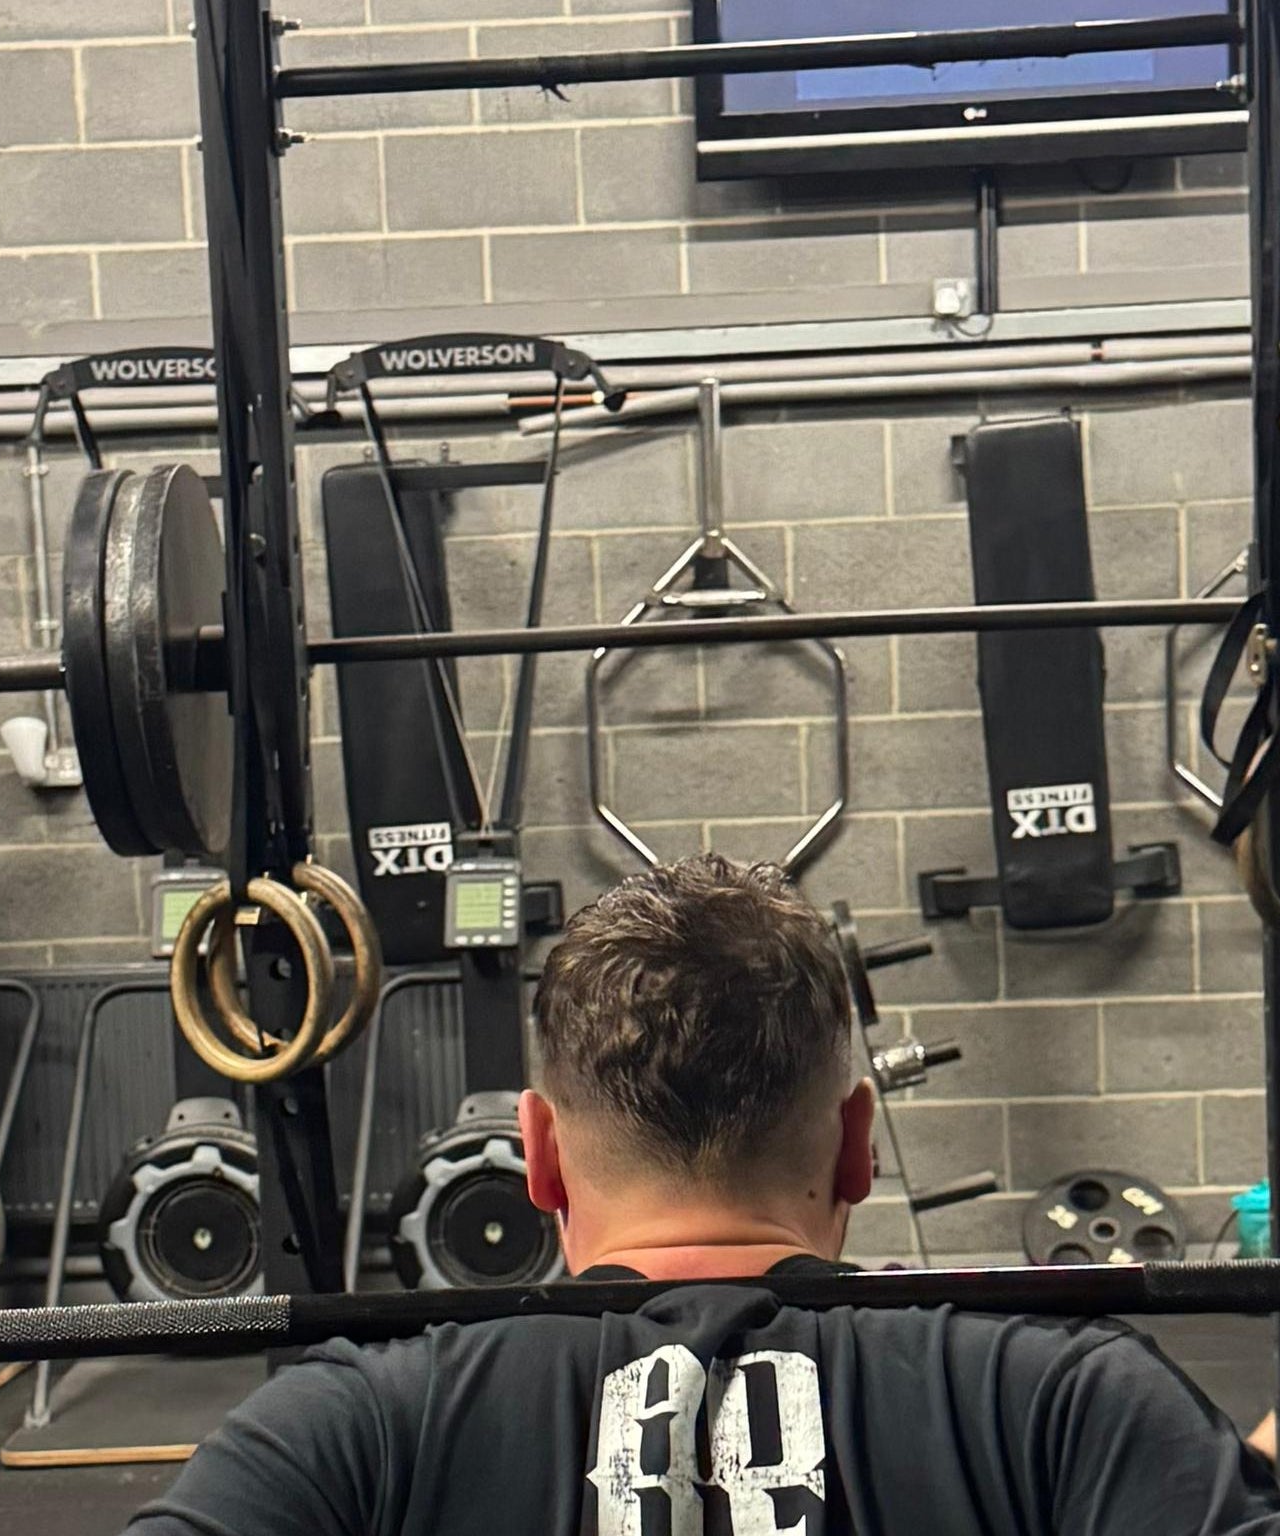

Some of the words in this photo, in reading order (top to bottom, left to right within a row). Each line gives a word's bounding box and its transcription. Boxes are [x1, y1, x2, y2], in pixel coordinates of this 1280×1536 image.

[90, 357, 216, 381] WOLVERSO
[379, 343, 535, 371] WOLVERSON
[1013, 789, 1089, 804] FITNESS
[373, 827, 448, 843] FITNESS
[1010, 806, 1097, 839] DTX
[371, 844, 454, 876] DTX
